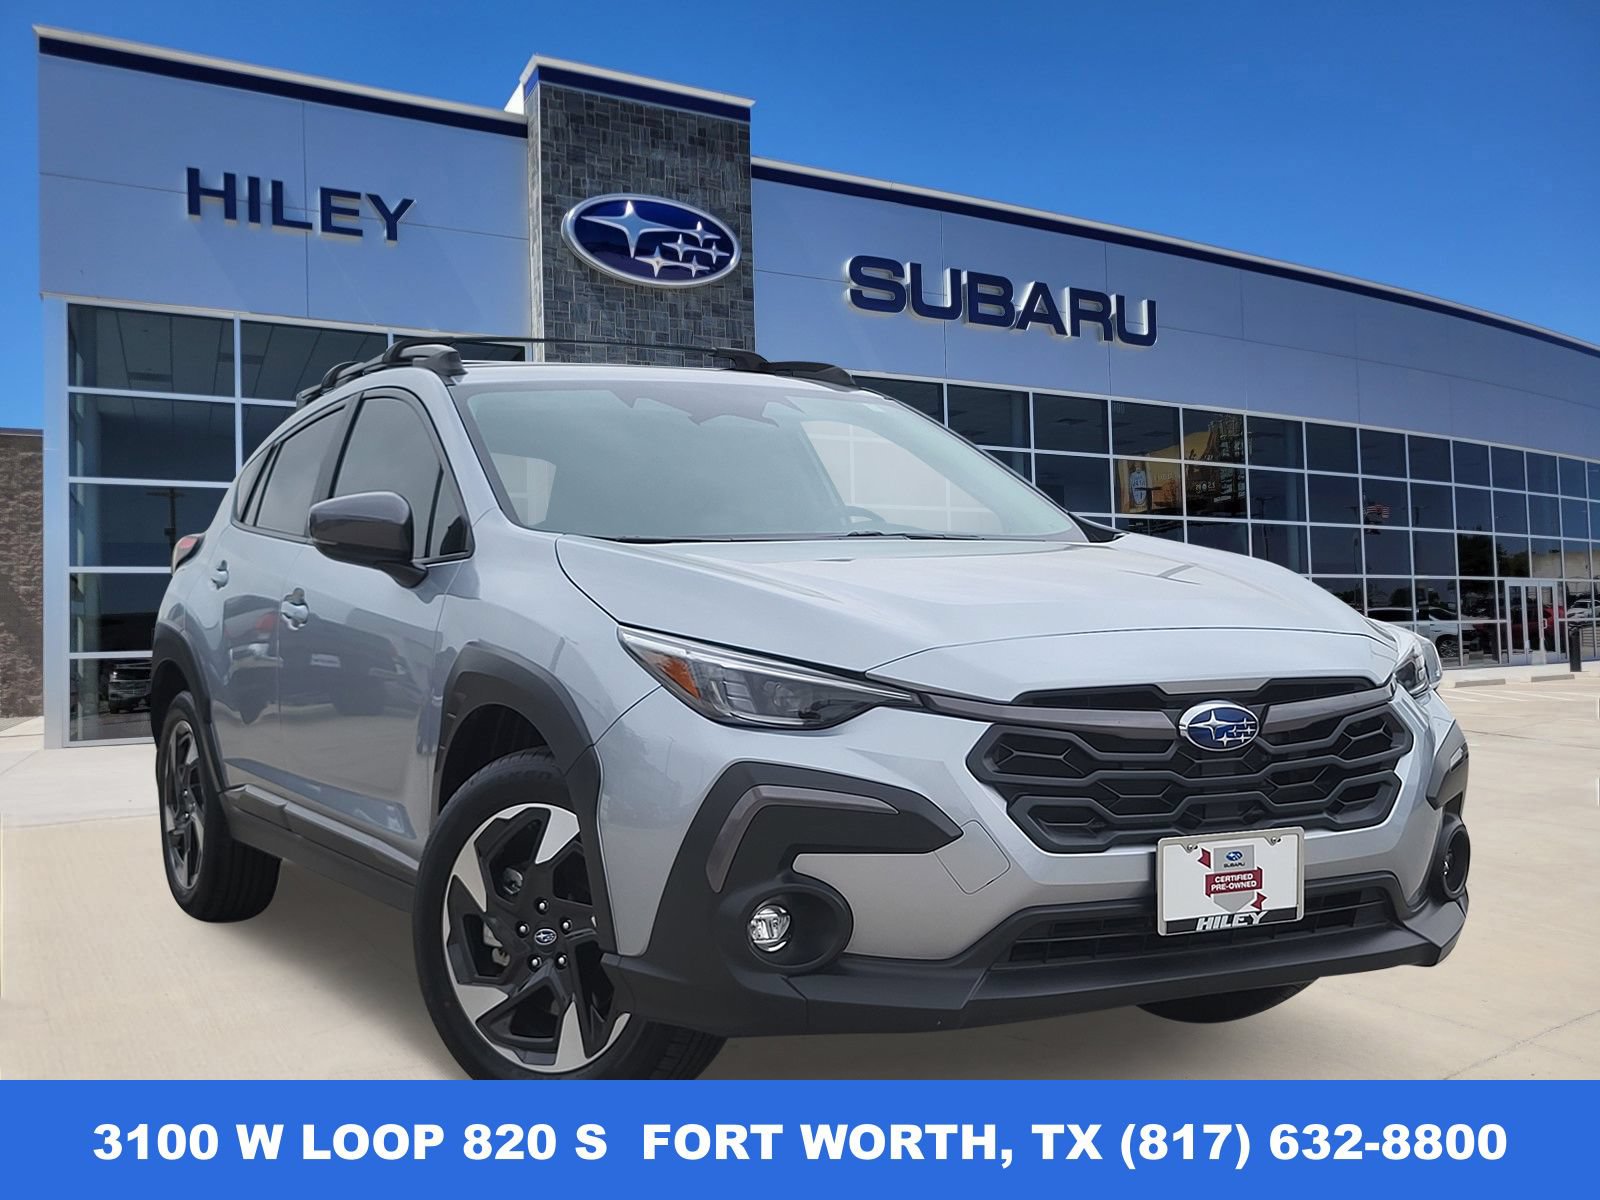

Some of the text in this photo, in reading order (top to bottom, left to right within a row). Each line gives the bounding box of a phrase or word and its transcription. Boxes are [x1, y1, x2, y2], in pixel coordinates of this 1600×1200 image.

[186, 166, 416, 243] HILEY
[846, 254, 1162, 348] SUBARU
[1210, 880, 1257, 891] PRE-OWNED
[1214, 873, 1253, 883] CERTIFIED
[1196, 911, 1268, 931] HILEY
